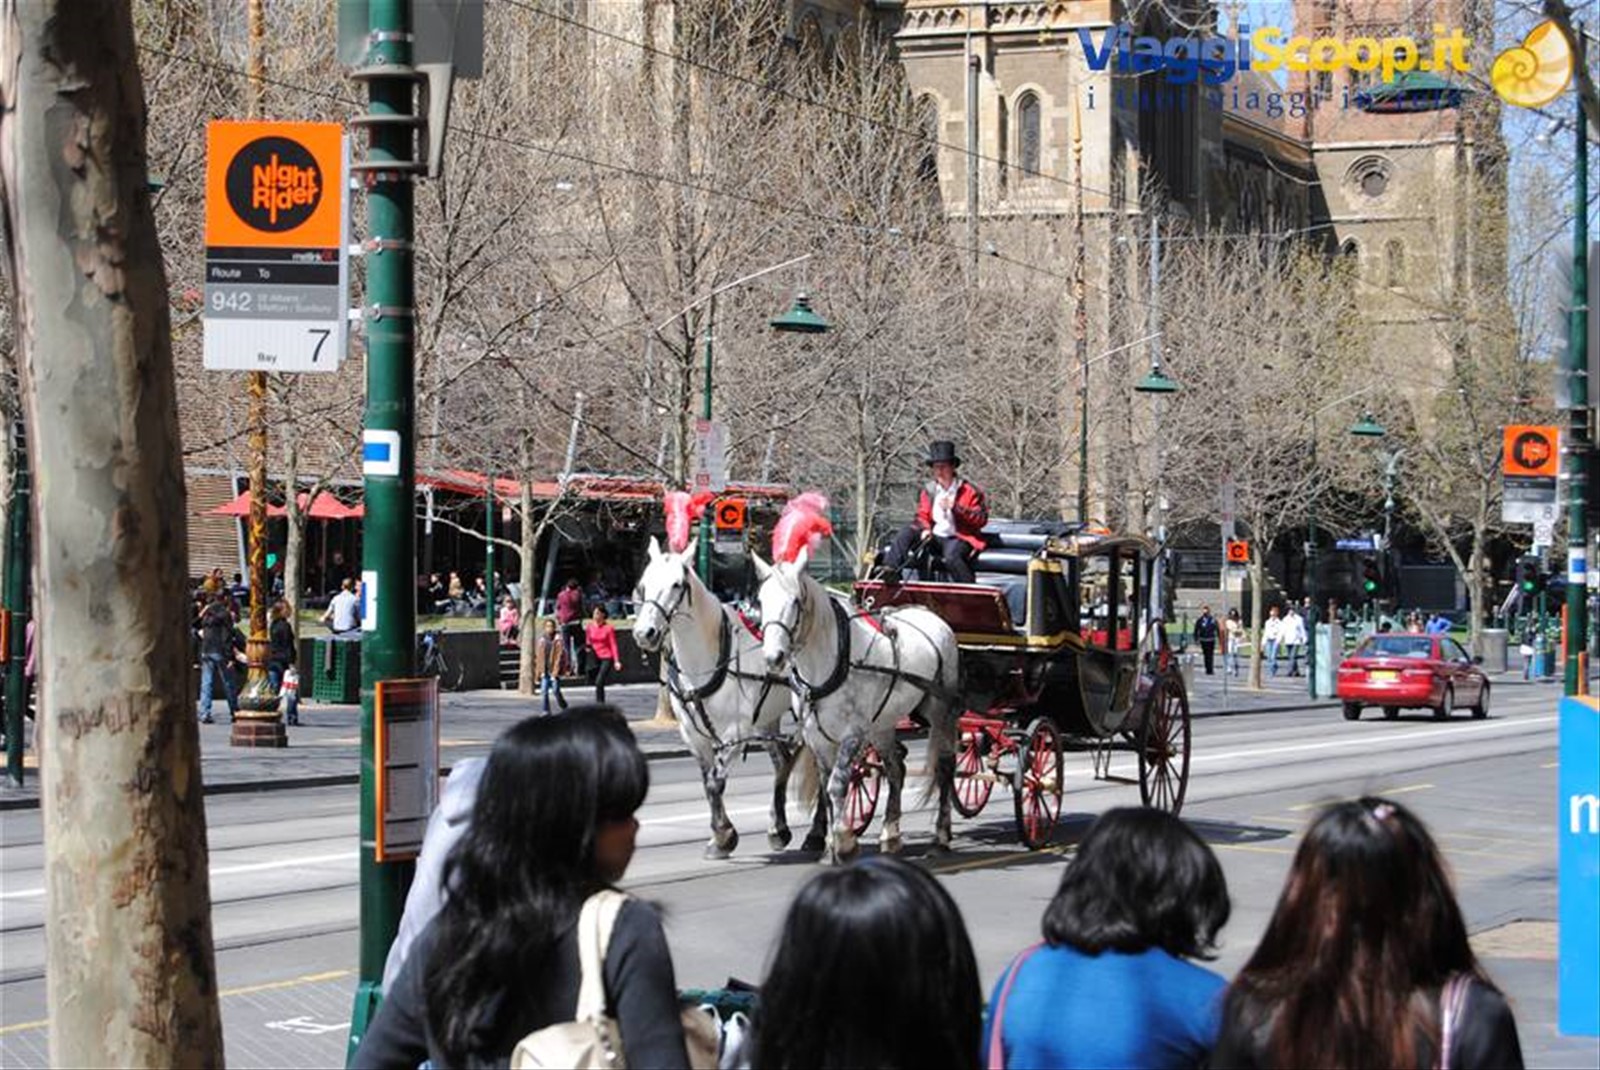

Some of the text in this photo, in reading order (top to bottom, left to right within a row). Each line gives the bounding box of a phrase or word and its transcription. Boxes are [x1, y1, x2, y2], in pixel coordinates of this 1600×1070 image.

[211, 267, 271, 279] Route To
[211, 292, 252, 312] 942
[307, 329, 331, 363] 7
[257, 353, 277, 364] Bay
